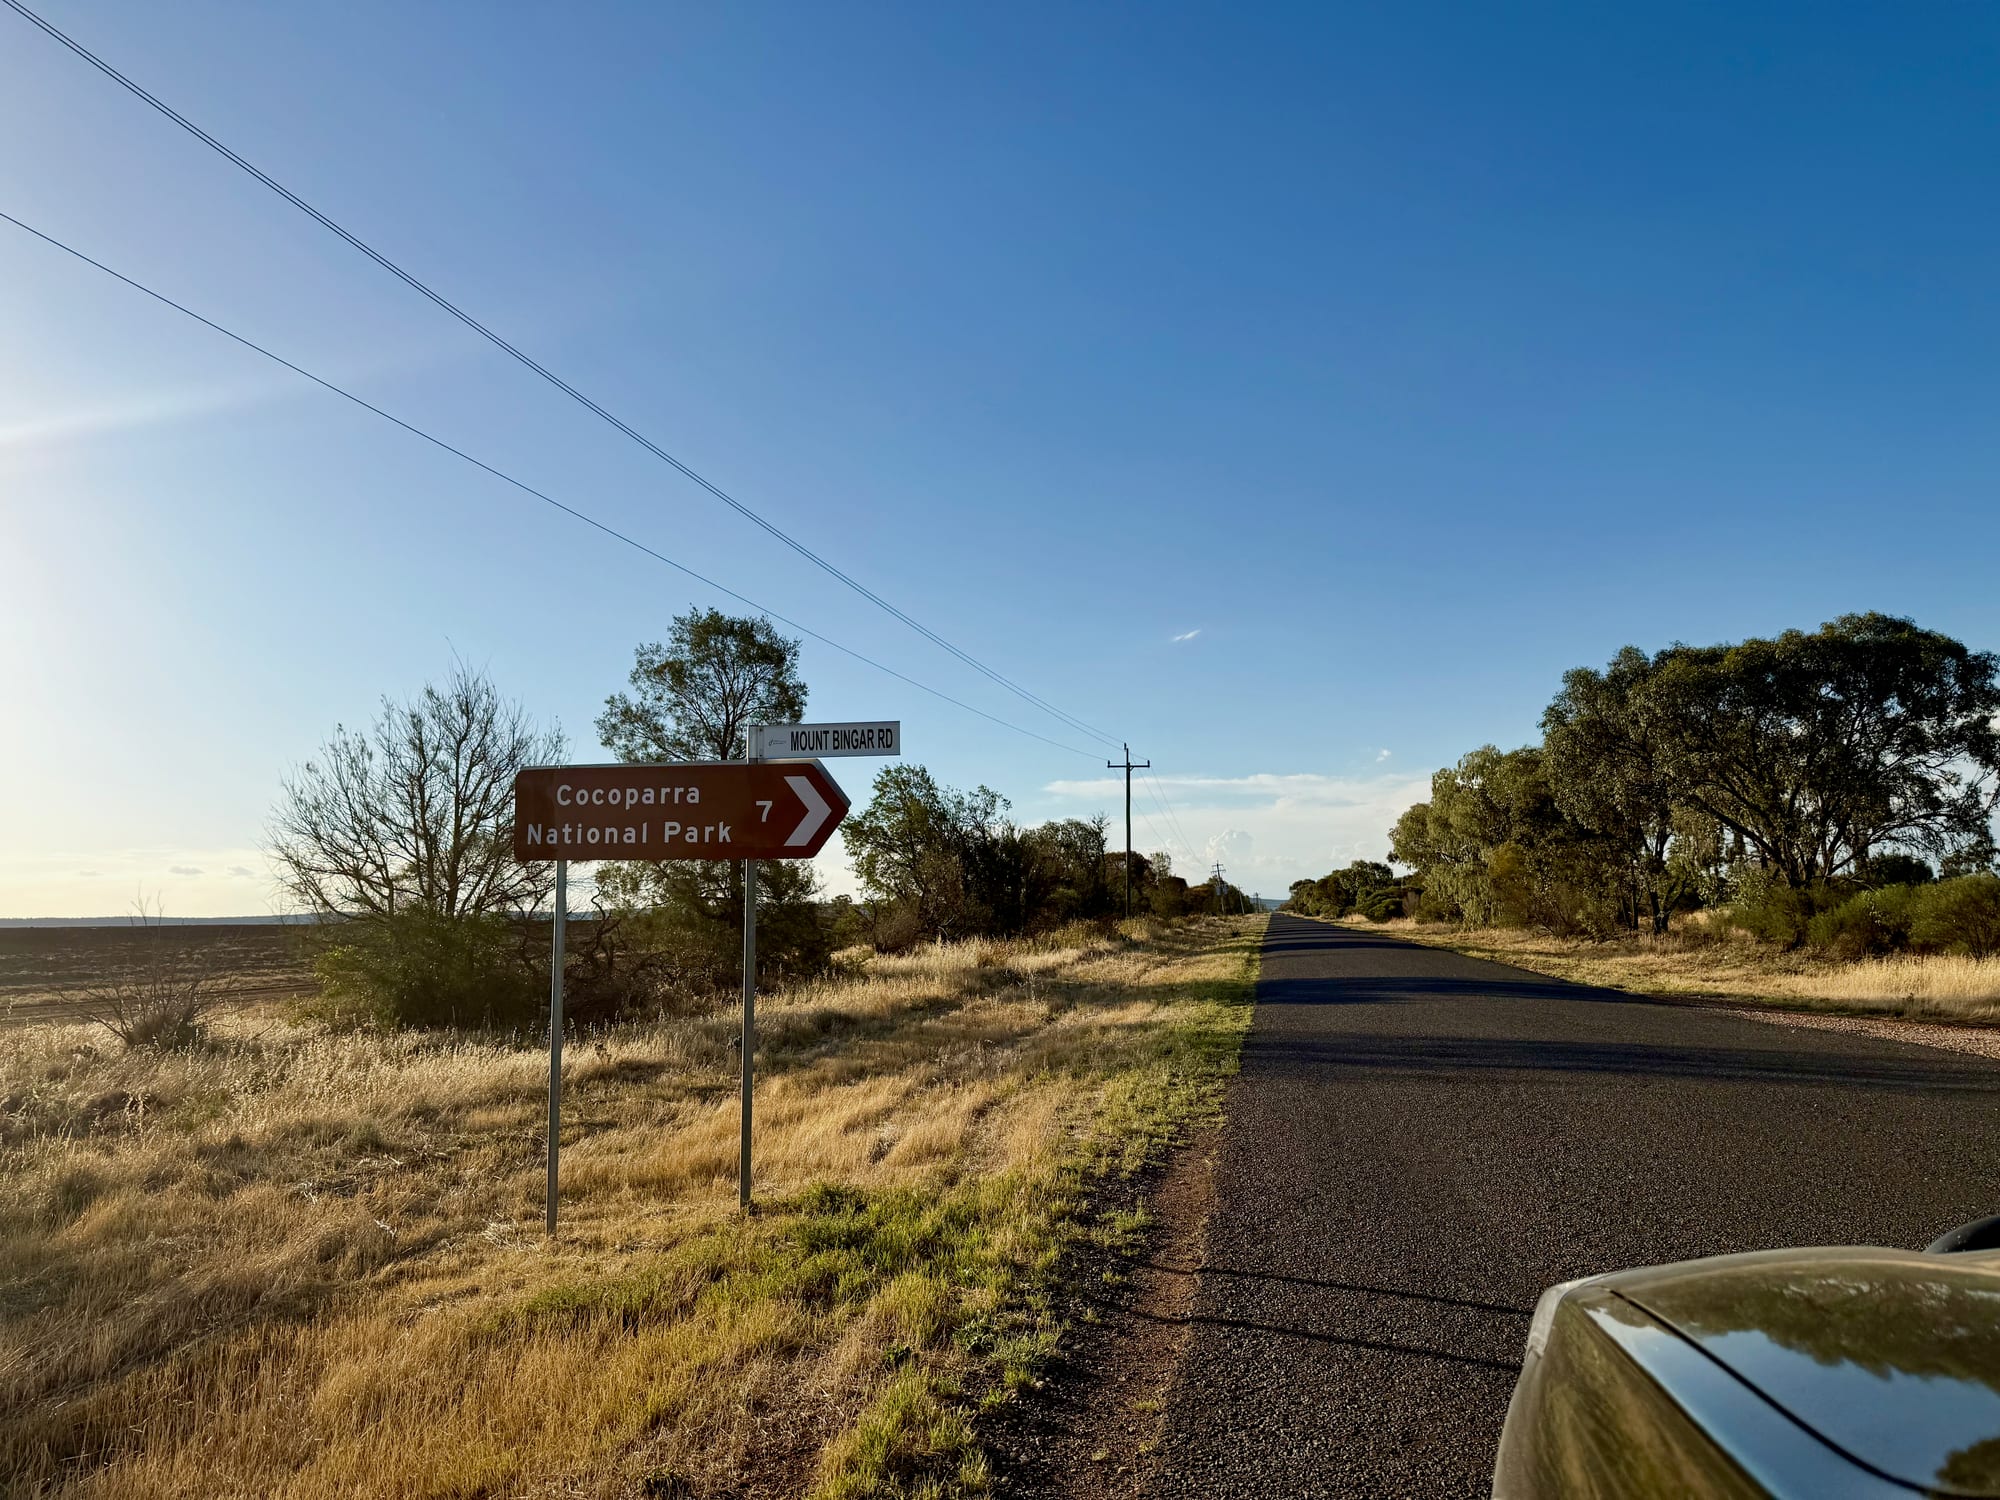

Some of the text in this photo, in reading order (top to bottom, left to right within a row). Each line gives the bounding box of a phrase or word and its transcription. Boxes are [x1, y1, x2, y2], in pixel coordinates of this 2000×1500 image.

[790, 728, 893, 751] MOUNT BINGAR RD
[556, 784, 700, 810] Cocoparra
[755, 800, 773, 823] 7
[526, 821, 732, 845] National Park
